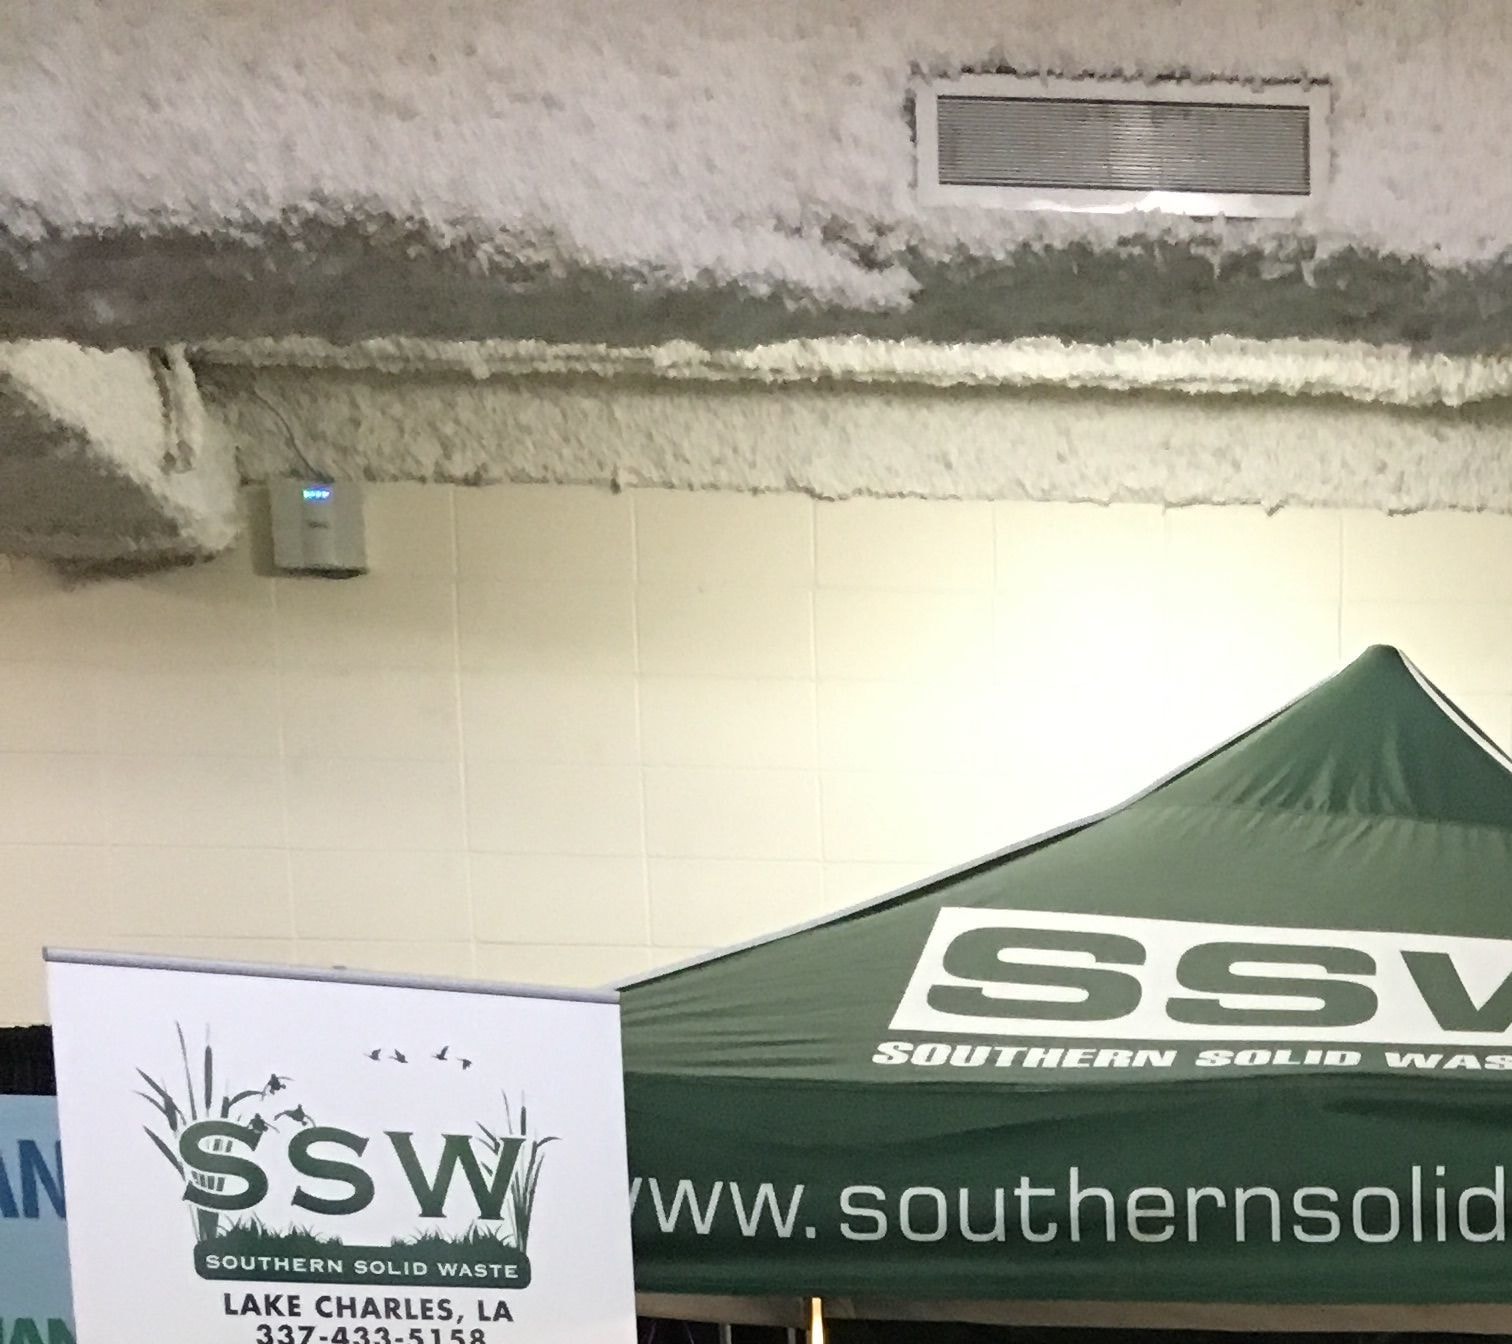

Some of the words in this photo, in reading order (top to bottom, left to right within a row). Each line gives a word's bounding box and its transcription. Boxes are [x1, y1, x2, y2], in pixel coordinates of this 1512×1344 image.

[872, 1041, 1177, 1068] SOUTHERN
[1196, 1048, 1361, 1068] SOLID
[178, 1119, 528, 1221] SSW
[205, 1253, 344, 1275] SOUTHERN
[354, 1259, 428, 1276] SOLID
[438, 1262, 519, 1279] WASTE
[223, 1292, 302, 1318] LAKE
[315, 1295, 465, 1325] CHARLES,
[478, 1299, 514, 1323] LA
